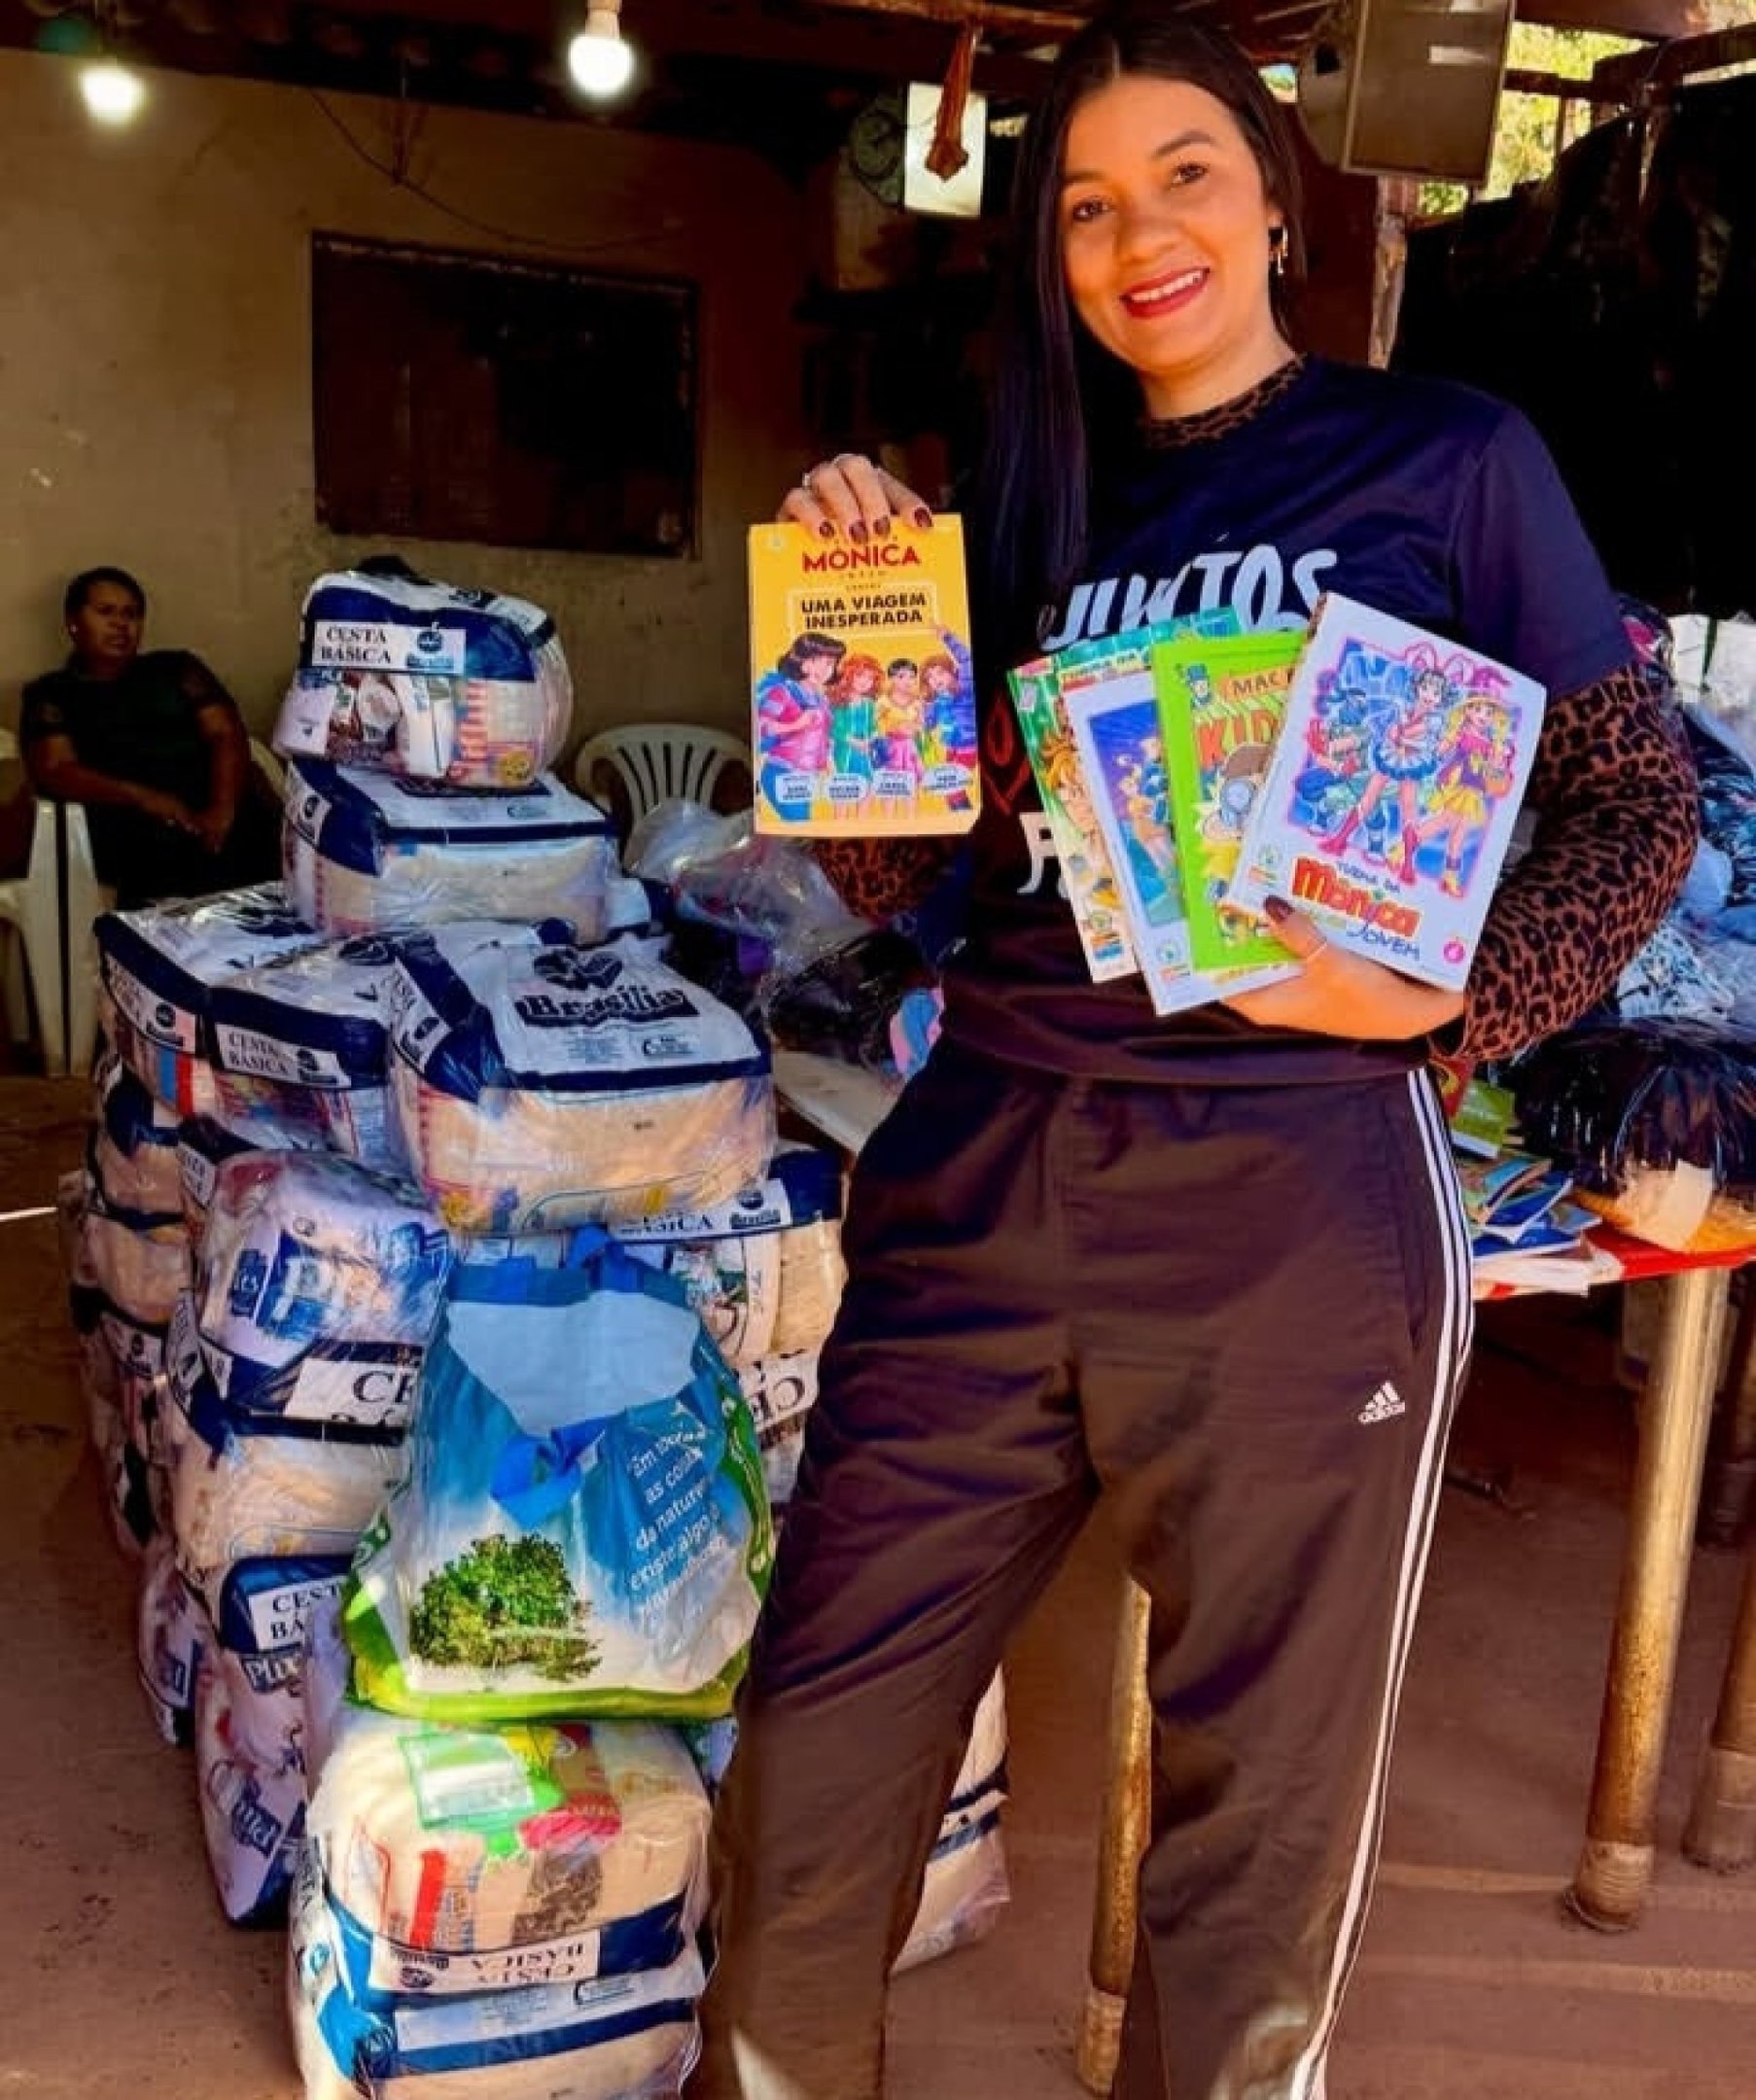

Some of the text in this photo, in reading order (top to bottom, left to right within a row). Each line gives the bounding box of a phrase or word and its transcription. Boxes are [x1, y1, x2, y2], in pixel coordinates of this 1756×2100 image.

[801, 592, 926, 614] UMA VIAGEM
[805, 609, 923, 630] INESPERADA
[326, 626, 387, 644] CESTA
